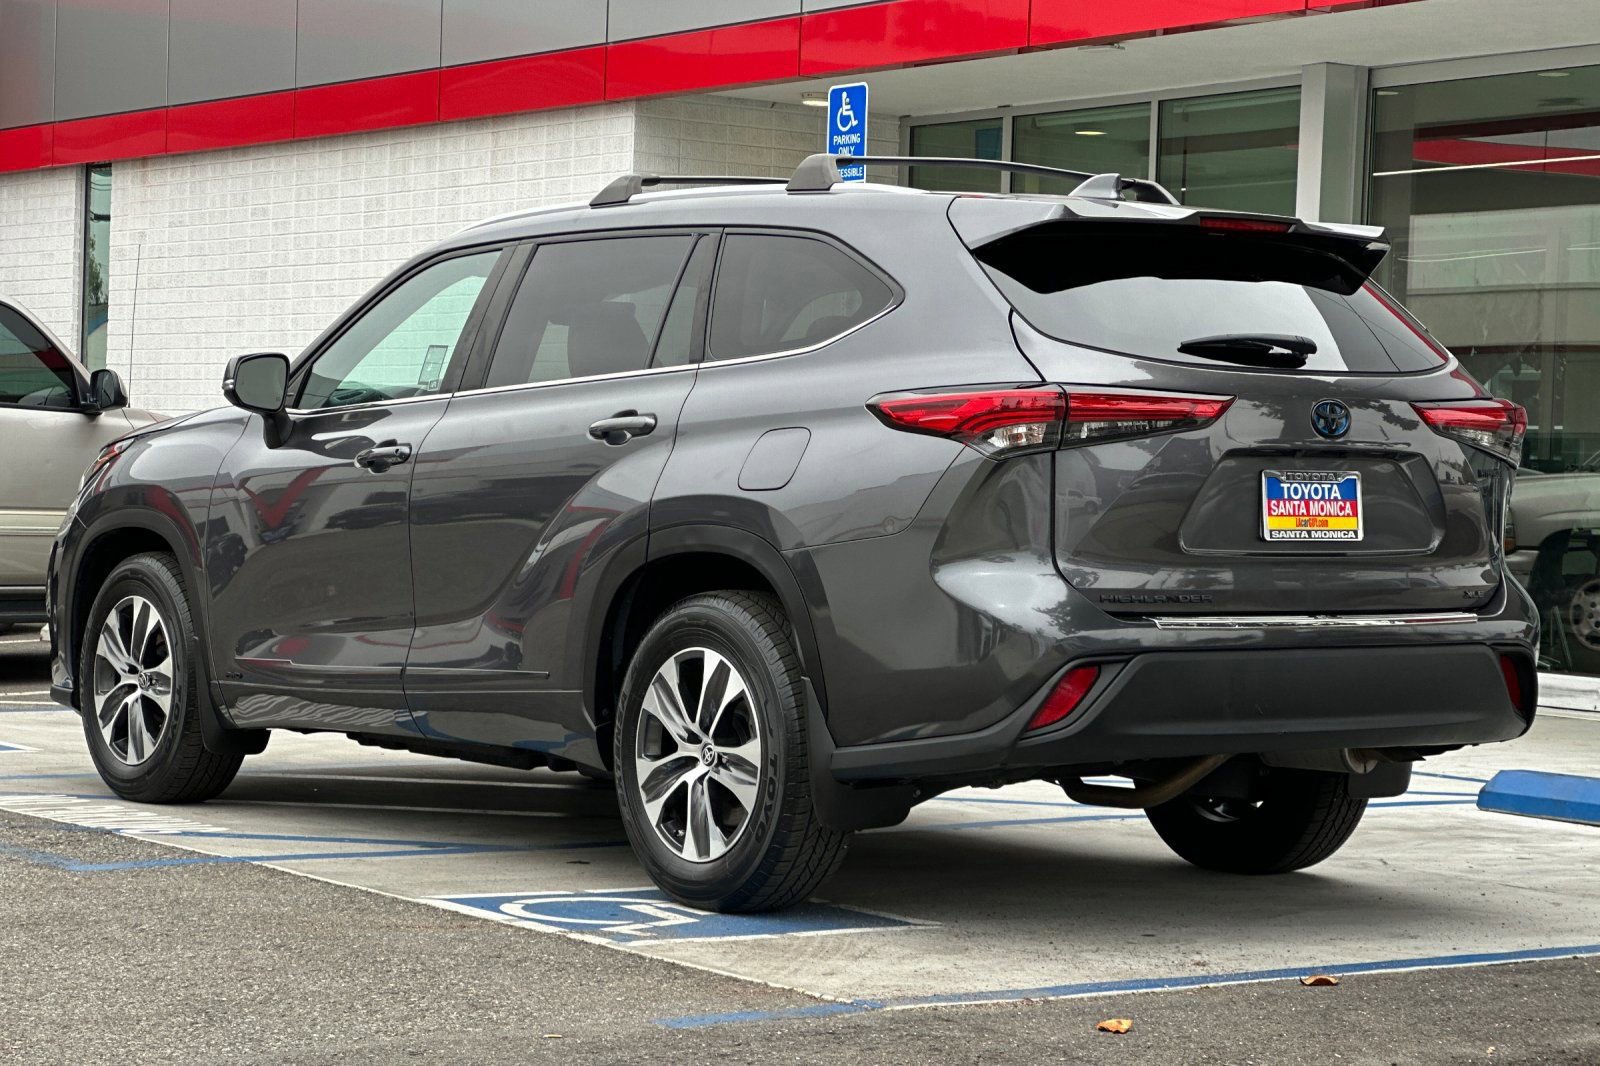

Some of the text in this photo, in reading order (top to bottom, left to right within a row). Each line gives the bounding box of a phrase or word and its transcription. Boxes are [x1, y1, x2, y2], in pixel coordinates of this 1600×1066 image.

[833, 133, 860, 146] PARKING
[838, 145, 856, 156] ONLY
[838, 167, 864, 177] ESSIBLE
[1287, 472, 1336, 481] TOYOTA
[1280, 484, 1341, 500] TOYOTA
[1271, 501, 1352, 516] SANTA MONICA
[1271, 530, 1356, 539] SANTA MONICA
[1099, 593, 1214, 604] HIGHLANDER
[754, 753, 779, 843] TOYO
